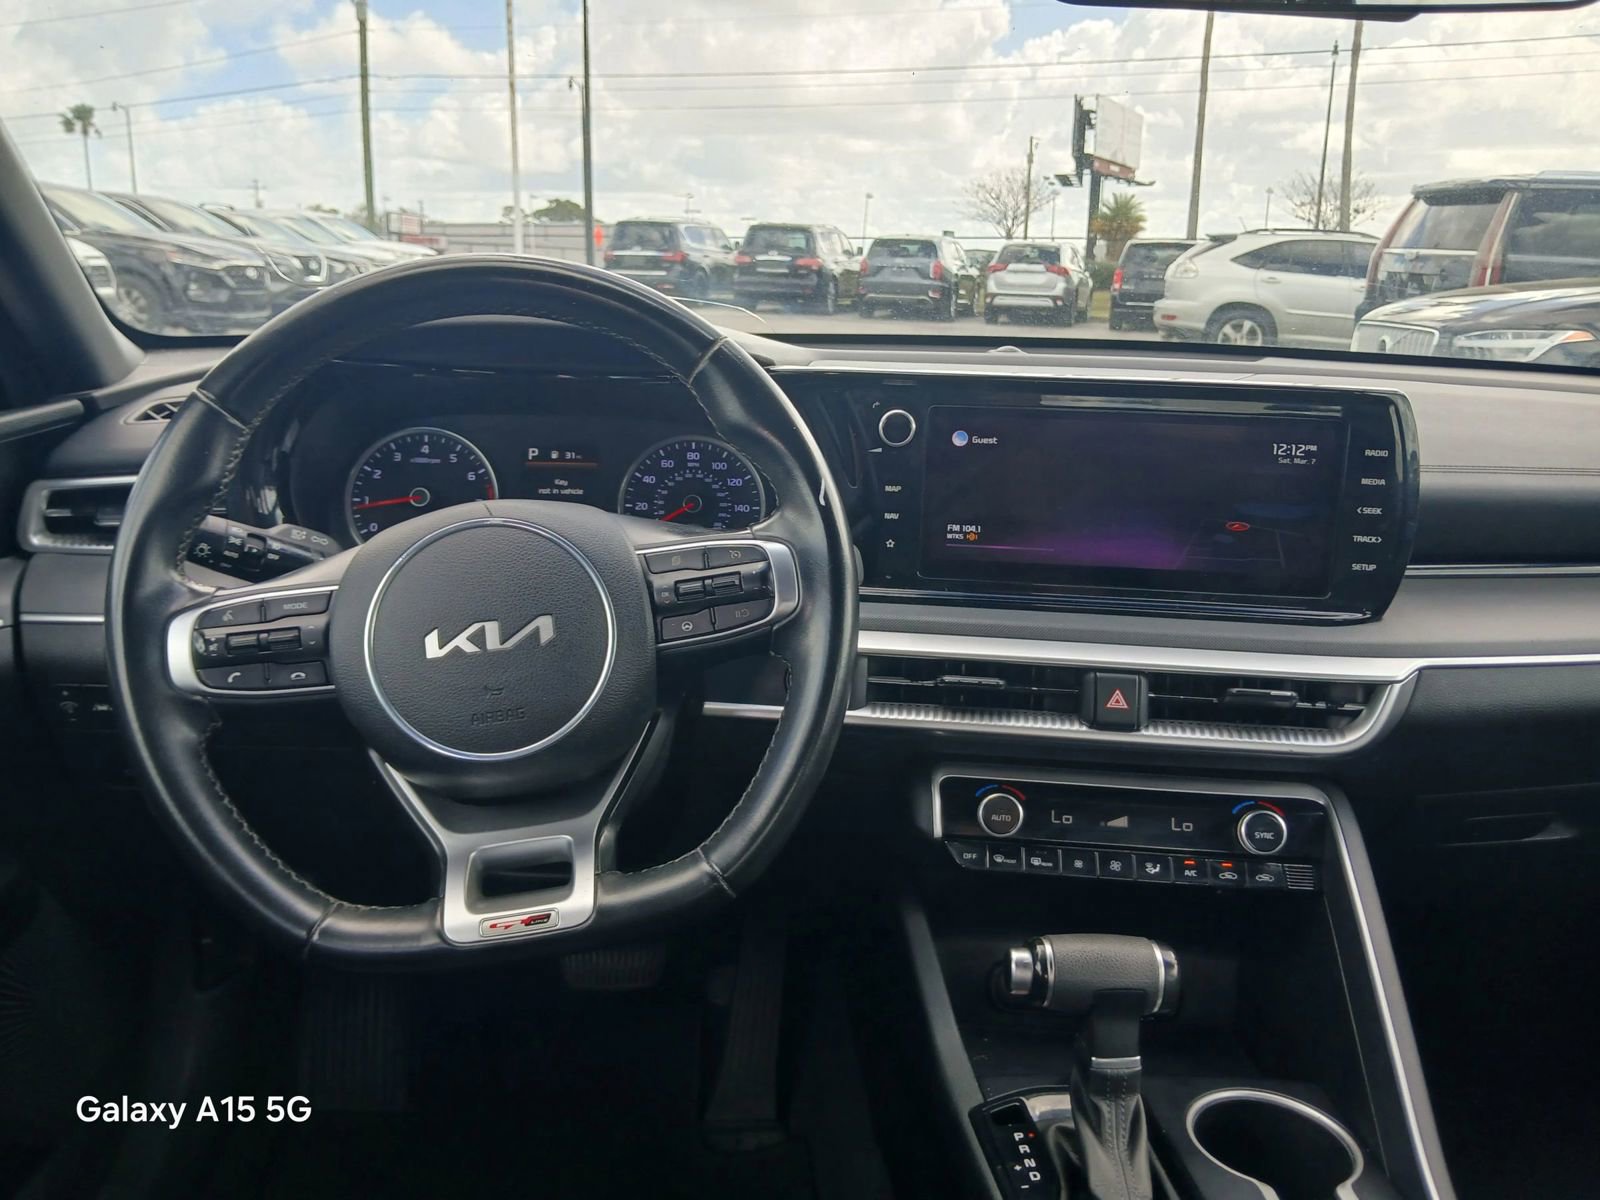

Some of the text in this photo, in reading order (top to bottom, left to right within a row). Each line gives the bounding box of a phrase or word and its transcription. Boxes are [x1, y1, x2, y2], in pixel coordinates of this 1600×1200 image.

[972, 436, 998, 445] Guest
[421, 445, 429, 454] 4
[528, 448, 575, 460] P 31
[1365, 449, 1389, 457] RADIO
[394, 453, 402, 461] 3
[450, 454, 458, 463] 5
[687, 452, 700, 460] 80
[661, 460, 674, 468] 60
[712, 462, 727, 470] 100
[373, 470, 382, 479] 2
[467, 472, 476, 481] 6
[642, 475, 655, 483] 40
[727, 478, 742, 486] 120
[1361, 478, 1386, 486] MEDIA
[635, 502, 648, 510] 20
[734, 504, 750, 512] 140
[884, 512, 899, 520] NAV
[369, 523, 378, 532] 0
[947, 524, 981, 533] FM 104.1
[1352, 563, 1377, 571] SETUP
[283, 602, 308, 610] MODE
[425, 614, 555, 659] KIA
[471, 708, 525, 725] AIRBAG
[991, 813, 1011, 822] AUTO
[1254, 831, 1275, 840] SYNC
[1184, 869, 1197, 877] A/C
[1013, 1132, 1024, 1141] P
[1018, 1144, 1031, 1154] R
[1024, 1158, 1036, 1168] N
[1029, 1171, 1041, 1181] D
